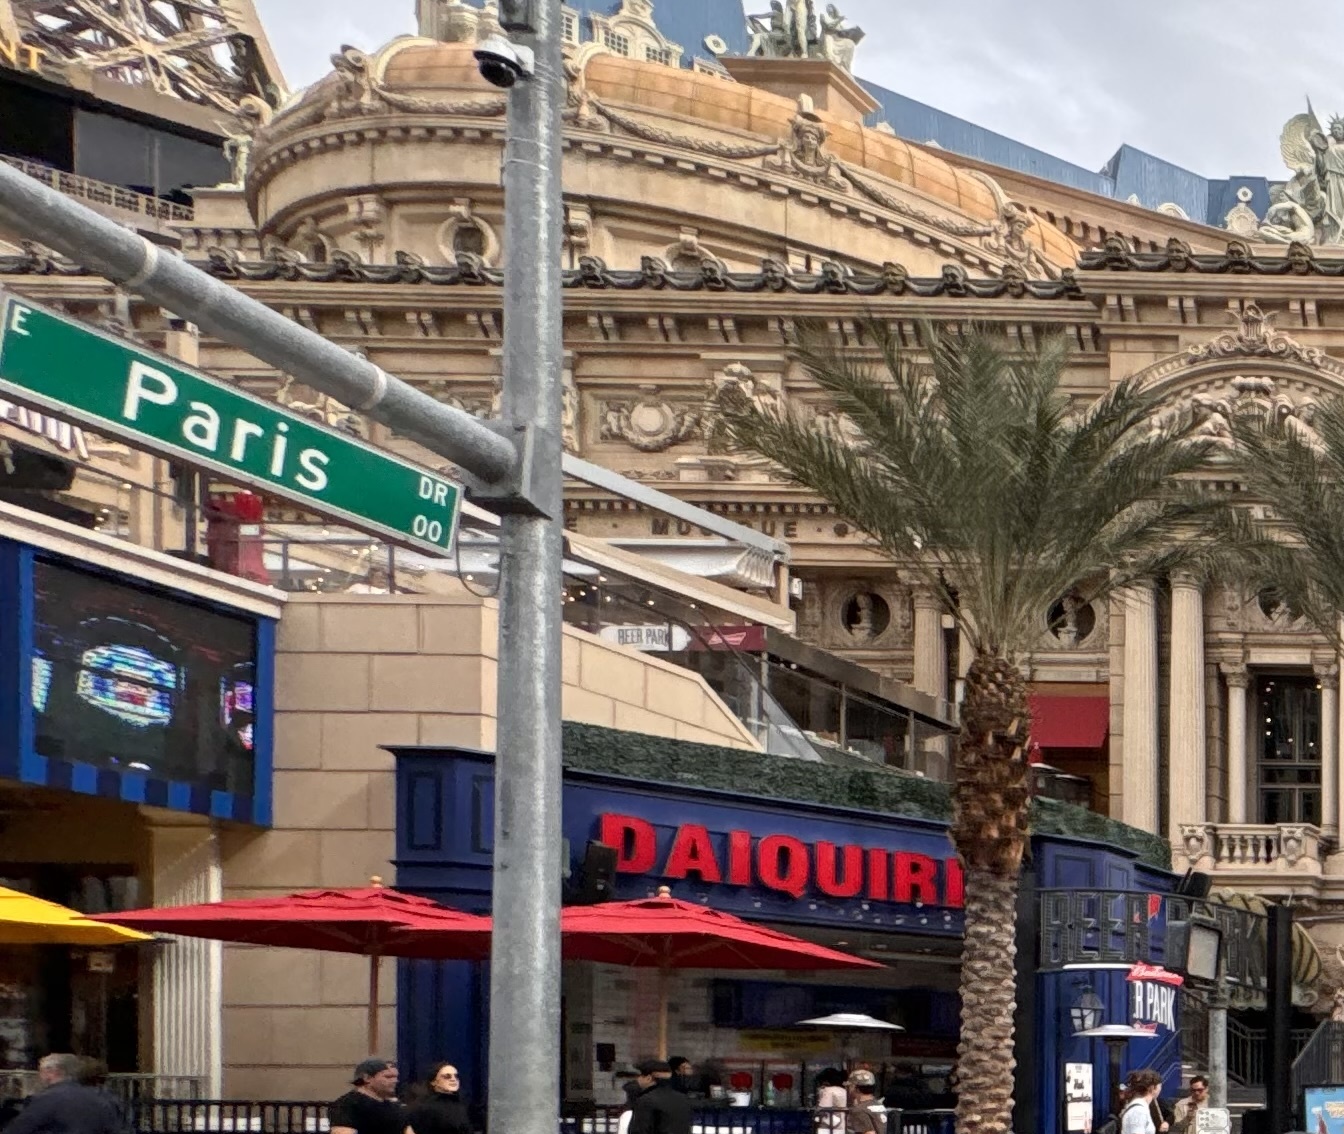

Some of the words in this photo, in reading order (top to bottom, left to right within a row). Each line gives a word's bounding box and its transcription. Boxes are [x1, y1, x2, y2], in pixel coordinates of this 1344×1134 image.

[11, 304, 32, 336] E
[123, 360, 330, 491] Paris
[418, 476, 448, 506] DR
[412, 515, 442, 543] 00
[652, 518, 798, 538] MUUE
[617, 628, 643, 646] BEER
[602, 813, 965, 908] DAIQUIRI
[1147, 981, 1176, 1033] PARK
